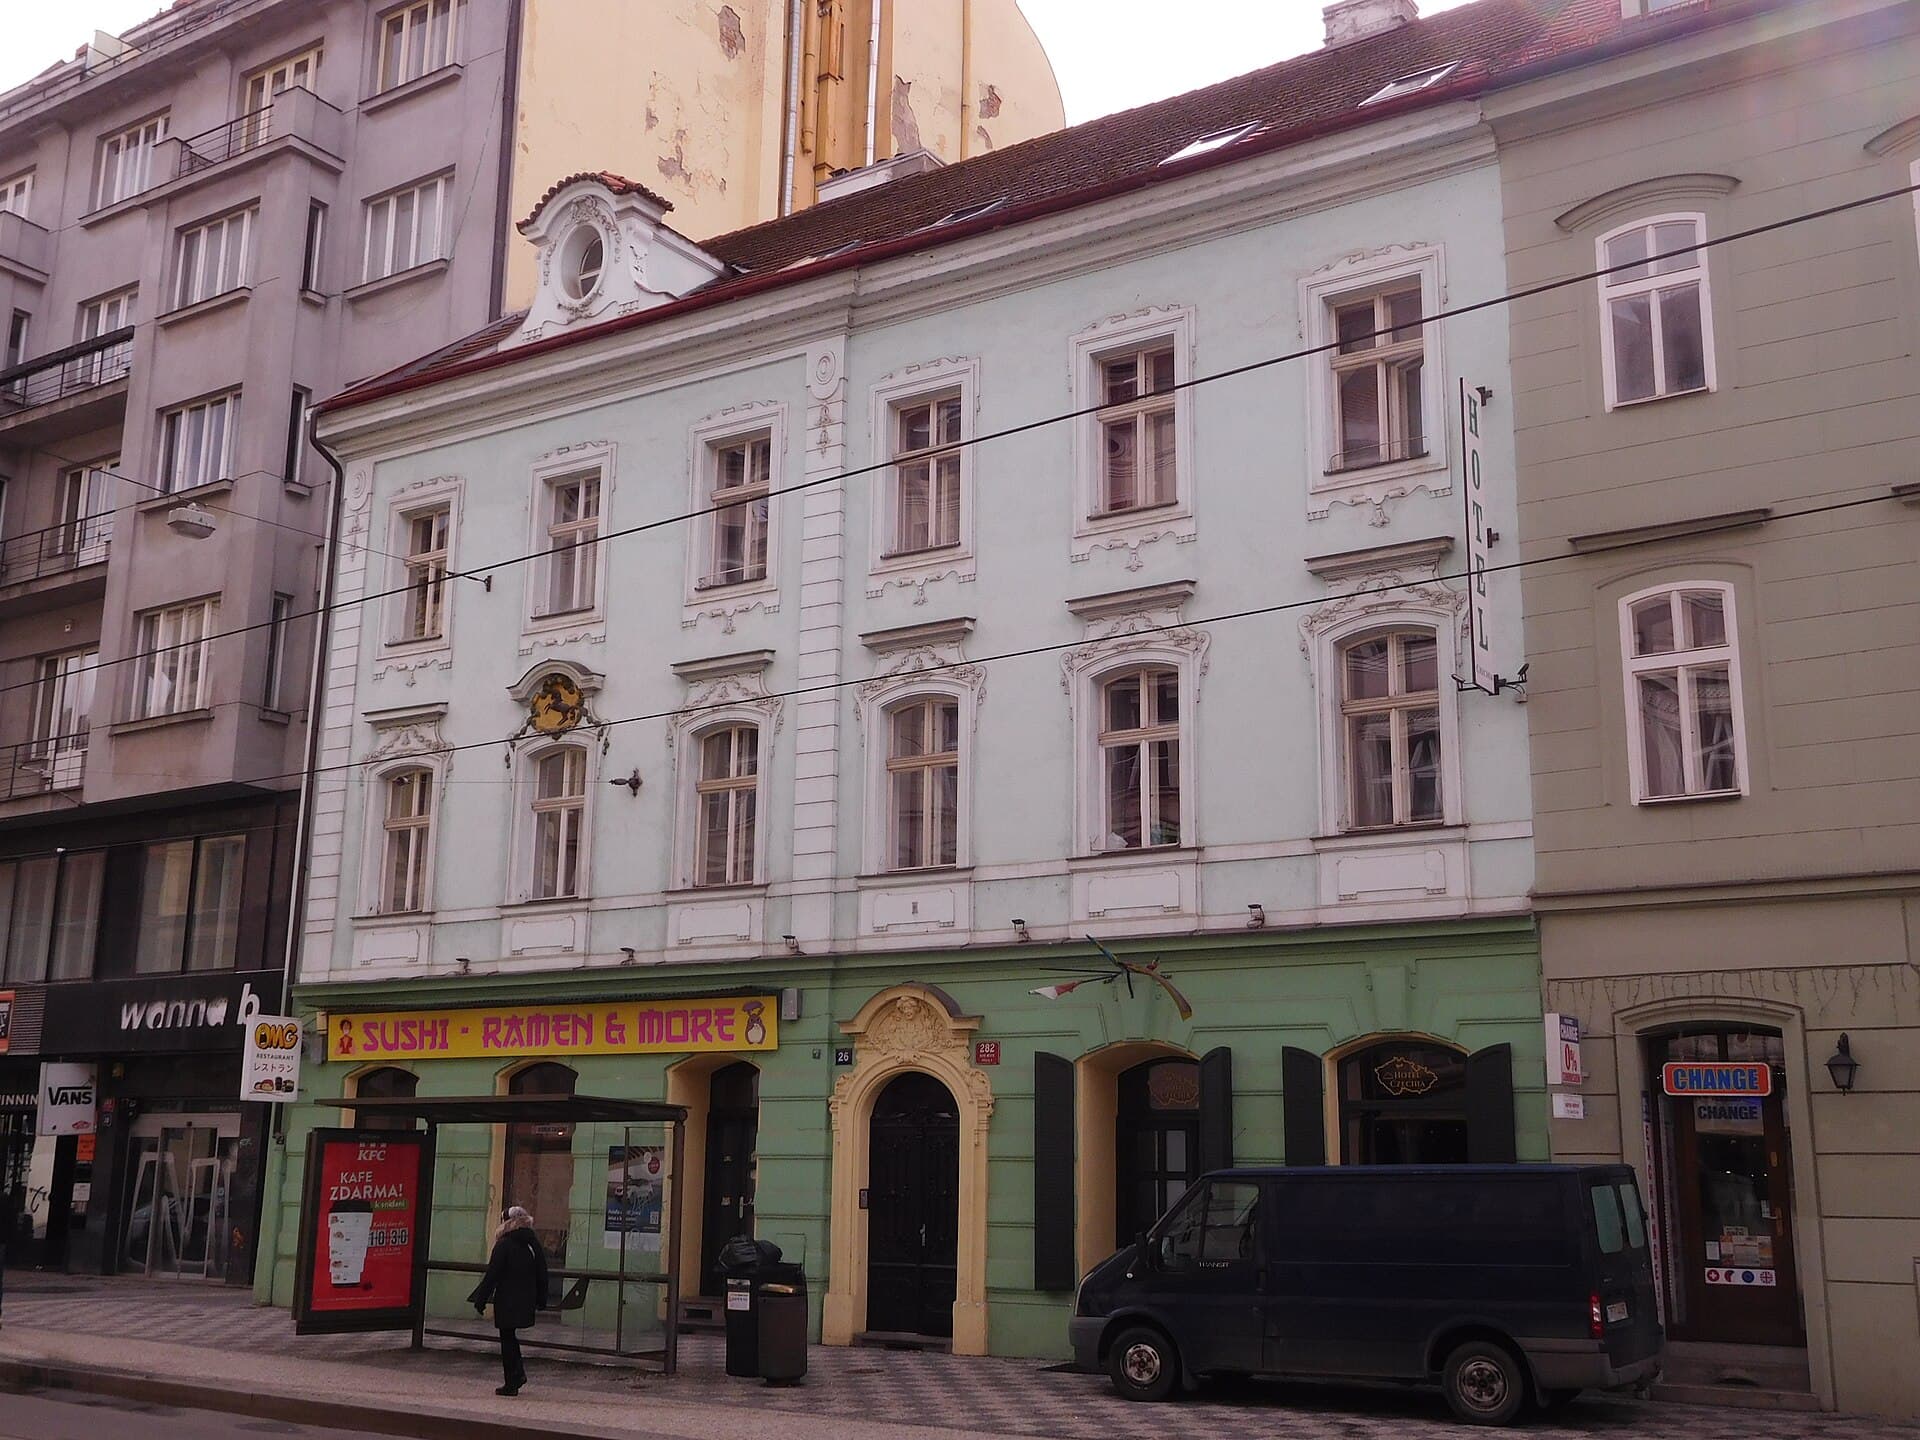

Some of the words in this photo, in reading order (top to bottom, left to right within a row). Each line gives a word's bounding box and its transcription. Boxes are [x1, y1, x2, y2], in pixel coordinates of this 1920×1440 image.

[1467, 394, 1489, 651] HOTEL
[120, 998, 229, 1030] wanna
[255, 1023, 298, 1050] OMG
[362, 1018, 449, 1051] SUSHI
[482, 1013, 593, 1048] RAMEN
[605, 1013, 626, 1042] &
[638, 1008, 736, 1044] MORE
[979, 1043, 996, 1053] 282
[838, 1051, 849, 1062] 26
[254, 1063, 294, 1073] レストラン
[1395, 1071, 1423, 1079] HOTEL
[1672, 1068, 1760, 1091] CHANGE
[48, 1087, 93, 1106] VANS
[1697, 1105, 1758, 1120] CHANGE
[357, 1149, 386, 1161] KFC
[340, 1171, 374, 1183] KAFE
[329, 1184, 404, 1200] ZDARMA!
[369, 1229, 407, 1246] 10:30
